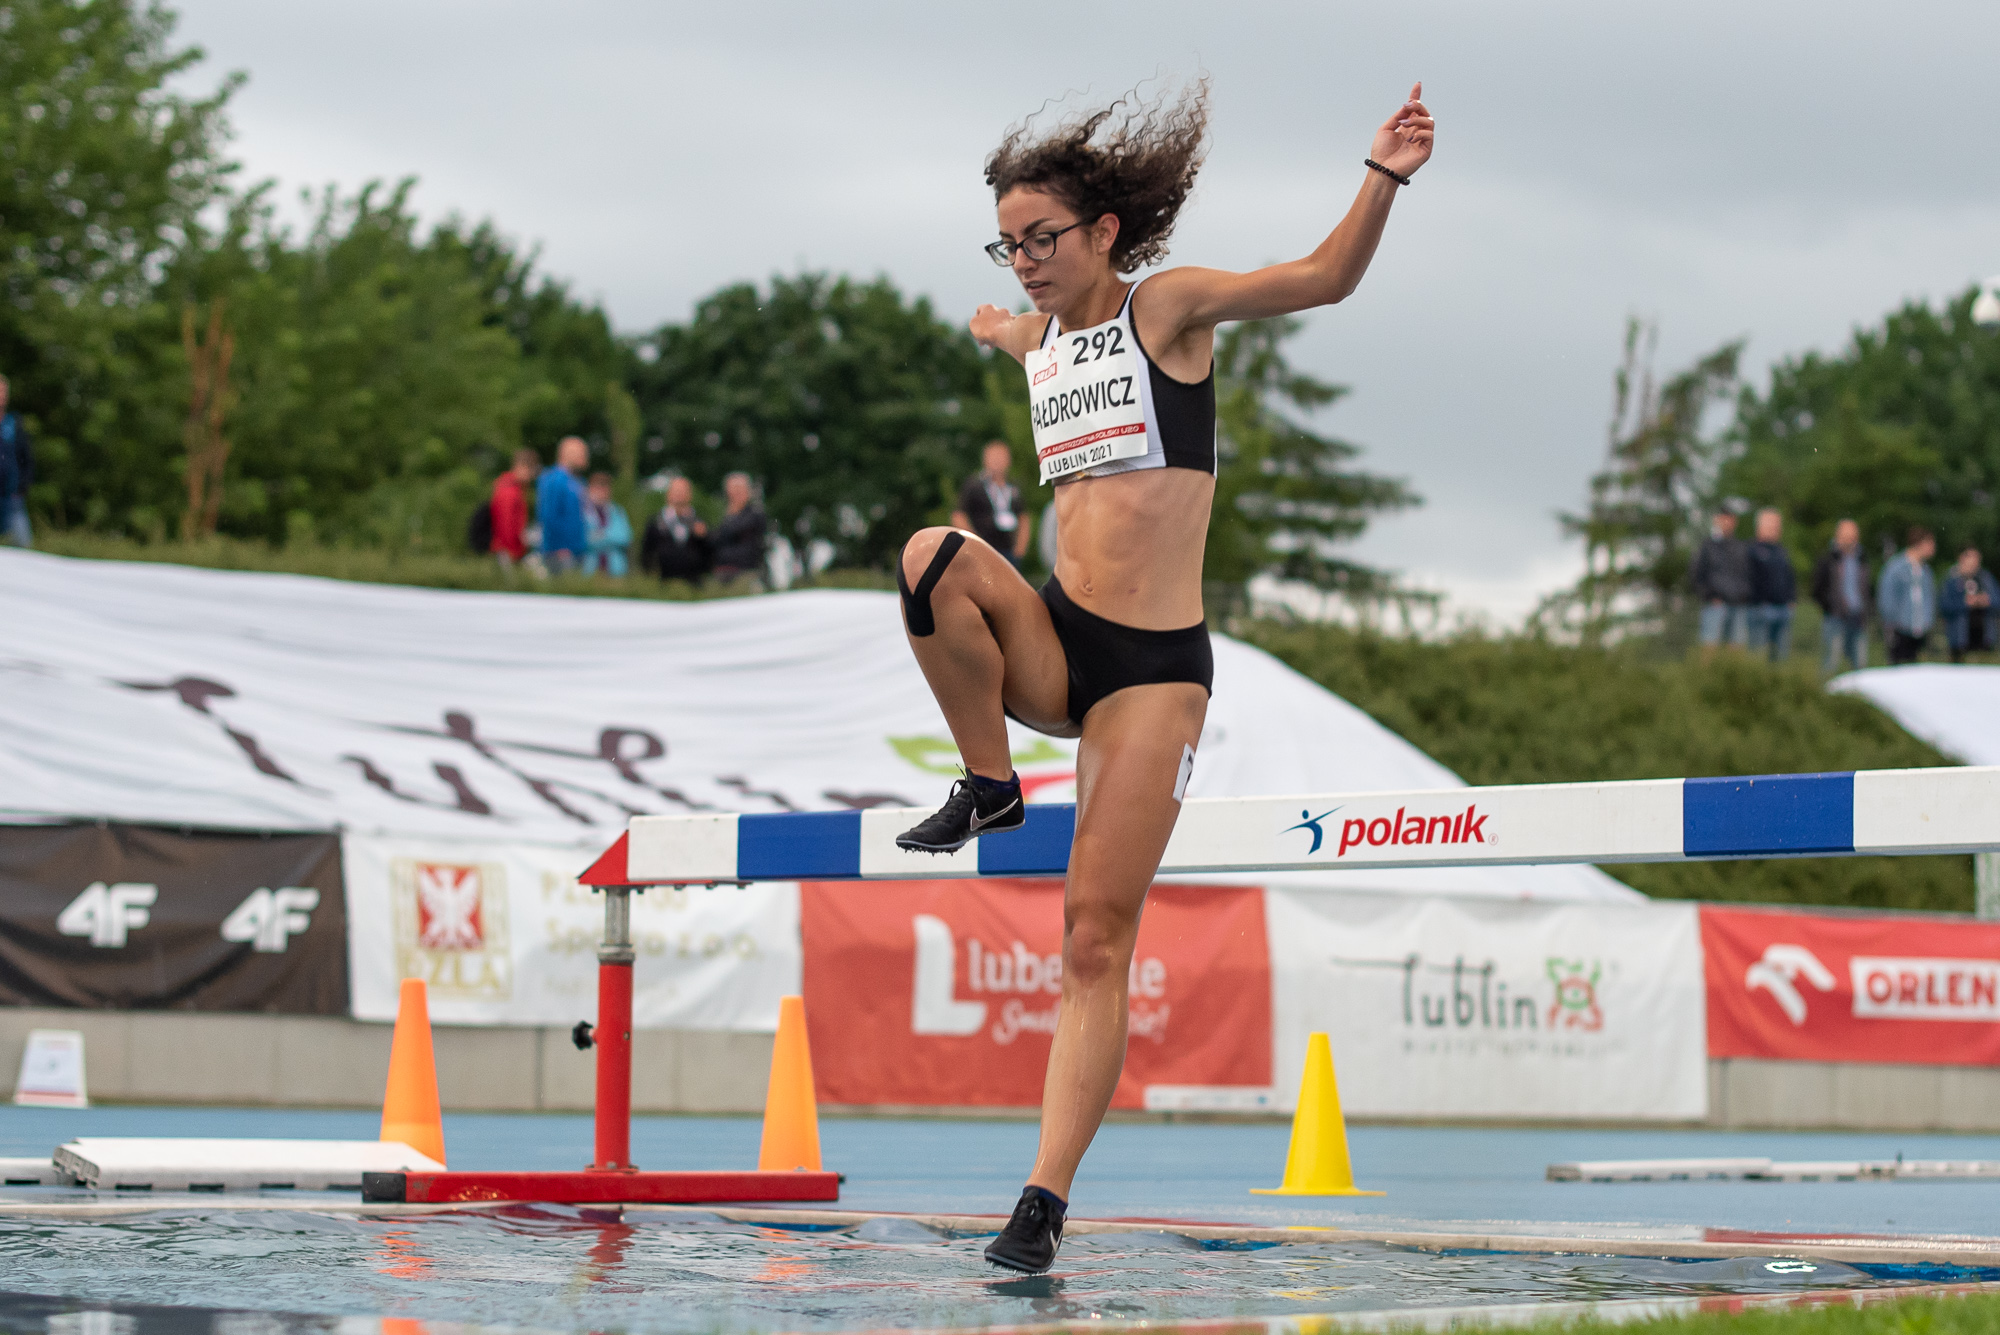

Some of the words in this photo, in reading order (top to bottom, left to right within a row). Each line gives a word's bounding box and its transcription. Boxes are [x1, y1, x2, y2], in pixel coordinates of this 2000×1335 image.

[1072, 326, 1126, 366] 292
[1031, 375, 1136, 430] AŁDROWICZ
[1047, 451, 1088, 475] LUBLIN
[1089, 443, 1113, 463] 2021
[1337, 803, 1490, 858] polanik
[56, 881, 159, 949] 4F
[220, 885, 321, 953] 4F
[967, 937, 1168, 999] lubeie
[1866, 970, 1996, 1007] ORLEN
